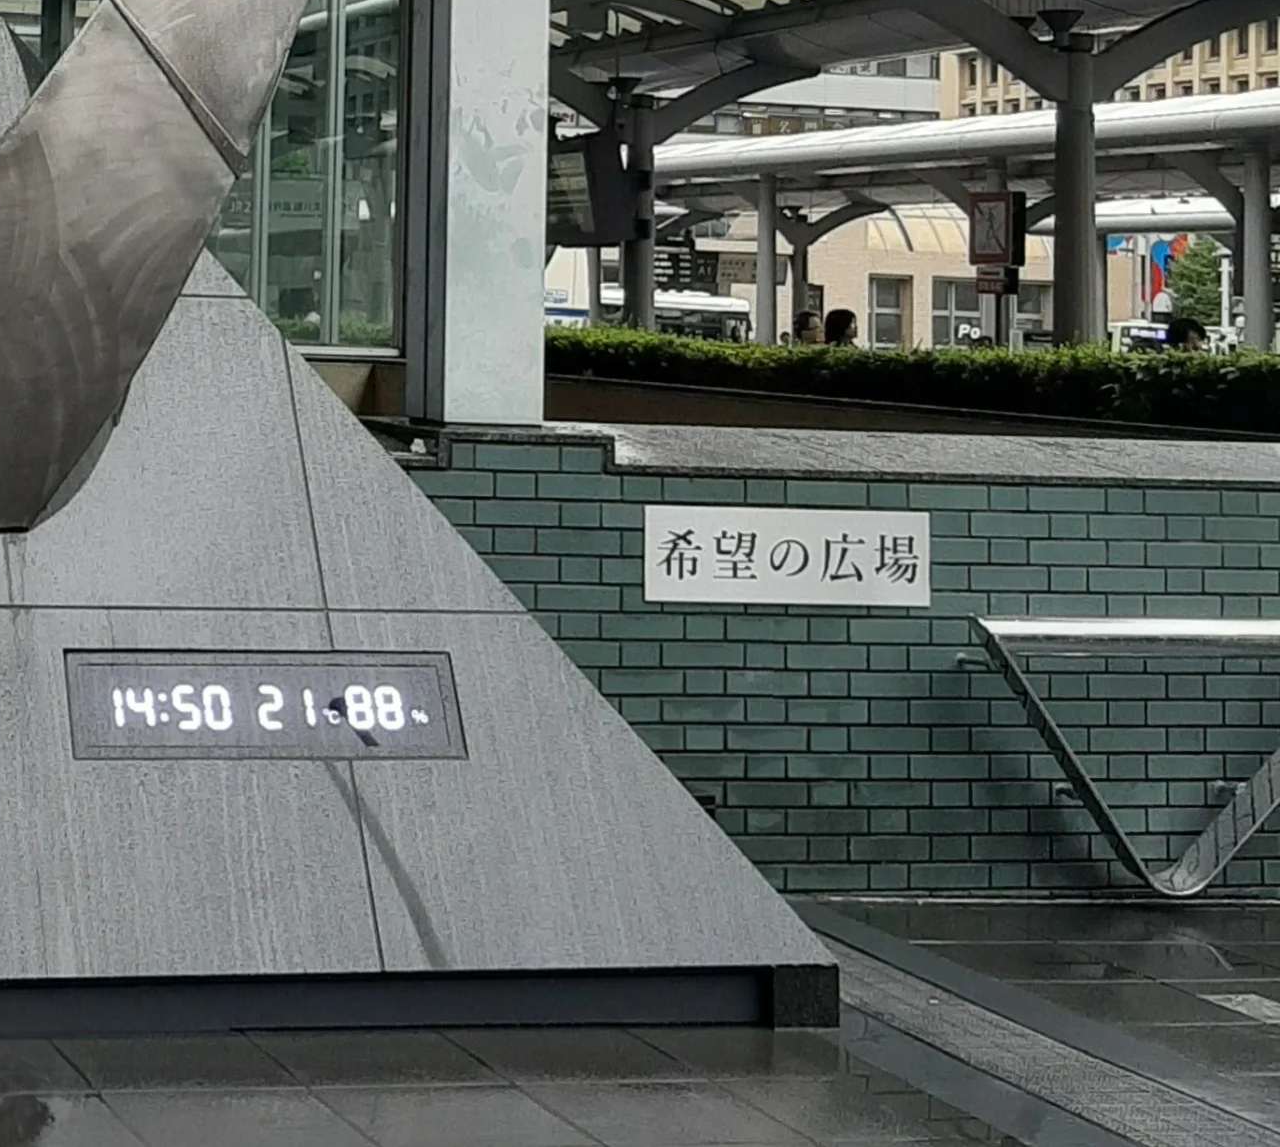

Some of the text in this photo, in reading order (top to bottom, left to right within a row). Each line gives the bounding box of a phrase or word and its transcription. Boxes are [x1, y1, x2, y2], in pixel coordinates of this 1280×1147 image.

[656, 527, 920, 585] 希望の広場
[111, 684, 234, 731] 14:50
